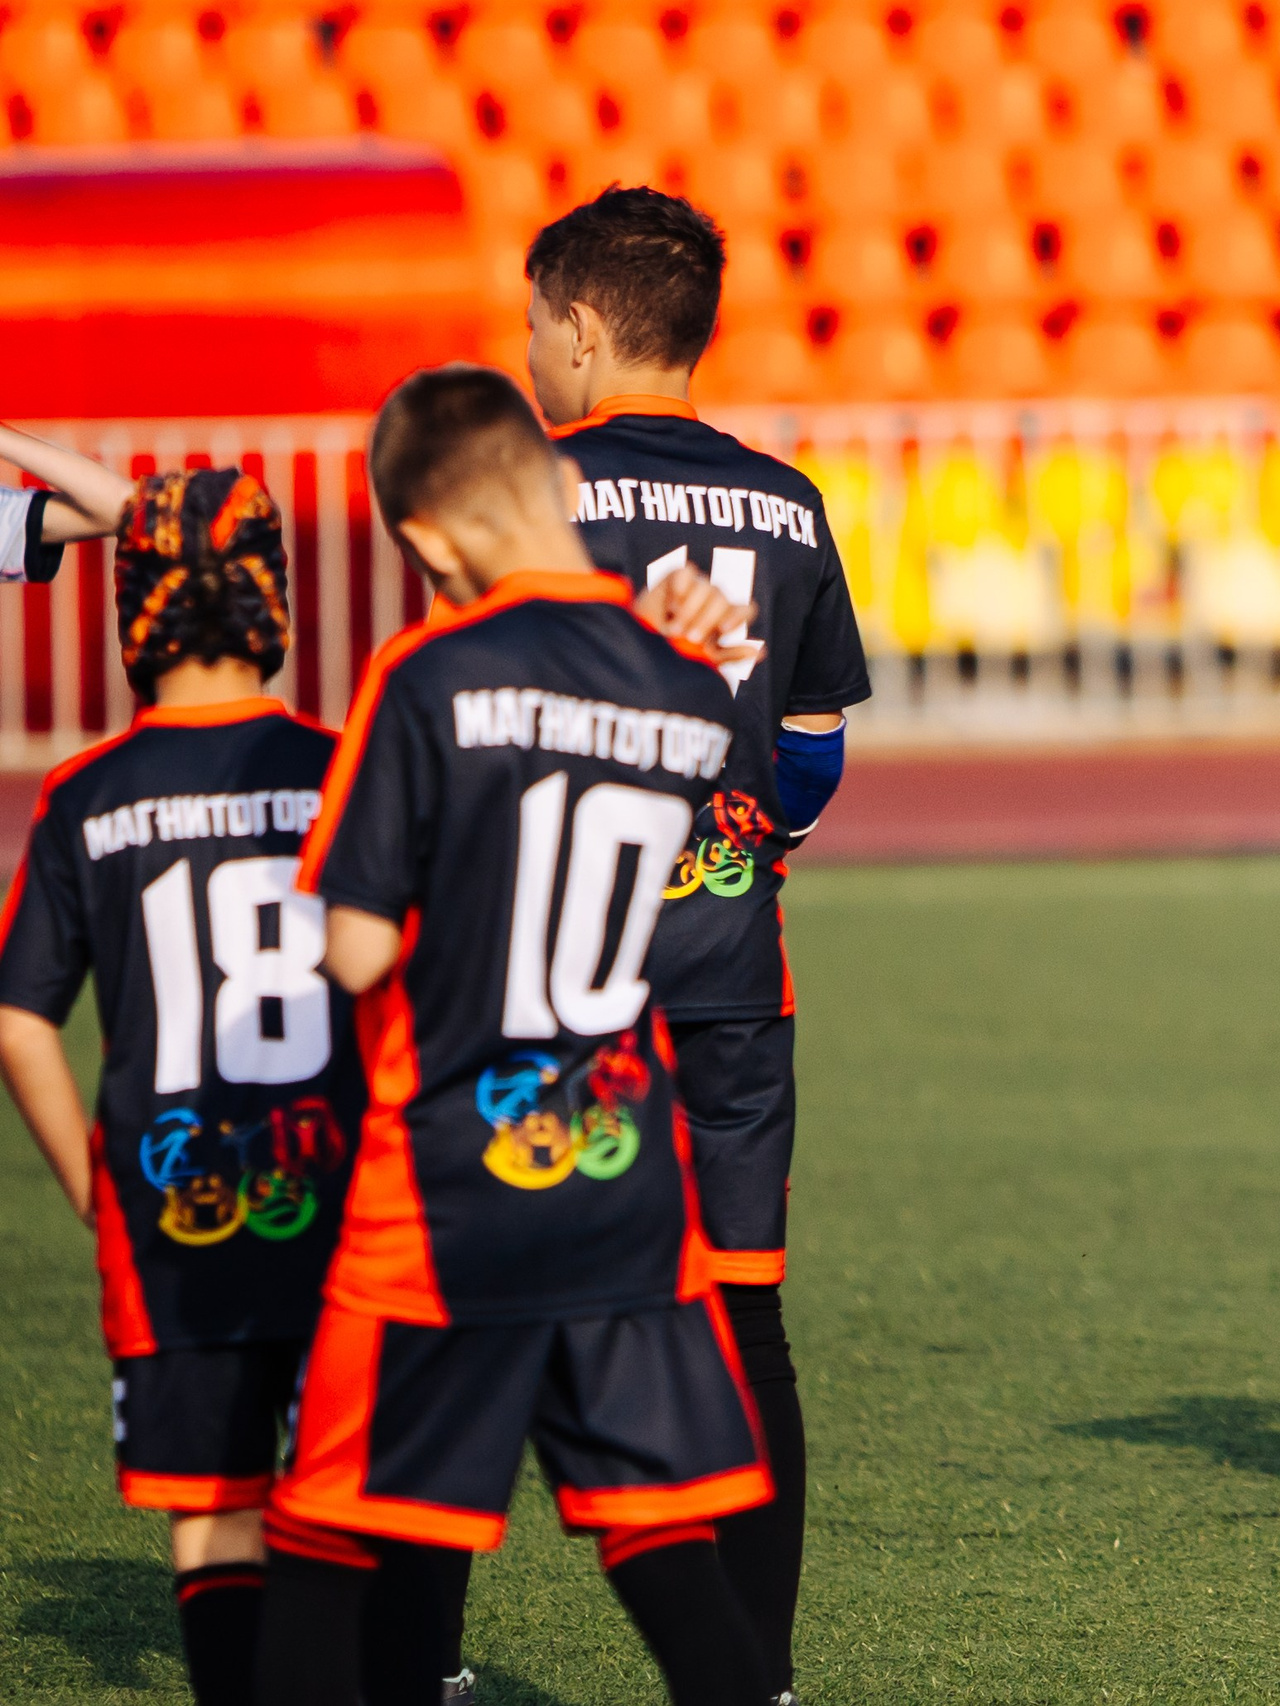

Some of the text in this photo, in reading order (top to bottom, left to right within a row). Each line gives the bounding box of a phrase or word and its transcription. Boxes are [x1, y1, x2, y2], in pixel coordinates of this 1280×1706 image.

[568, 477, 818, 549] МАГНИТОГОРСК
[83, 788, 323, 861] МАГНИТОГОР
[141, 856, 332, 1095] 18
[501, 769, 694, 1039] 10
